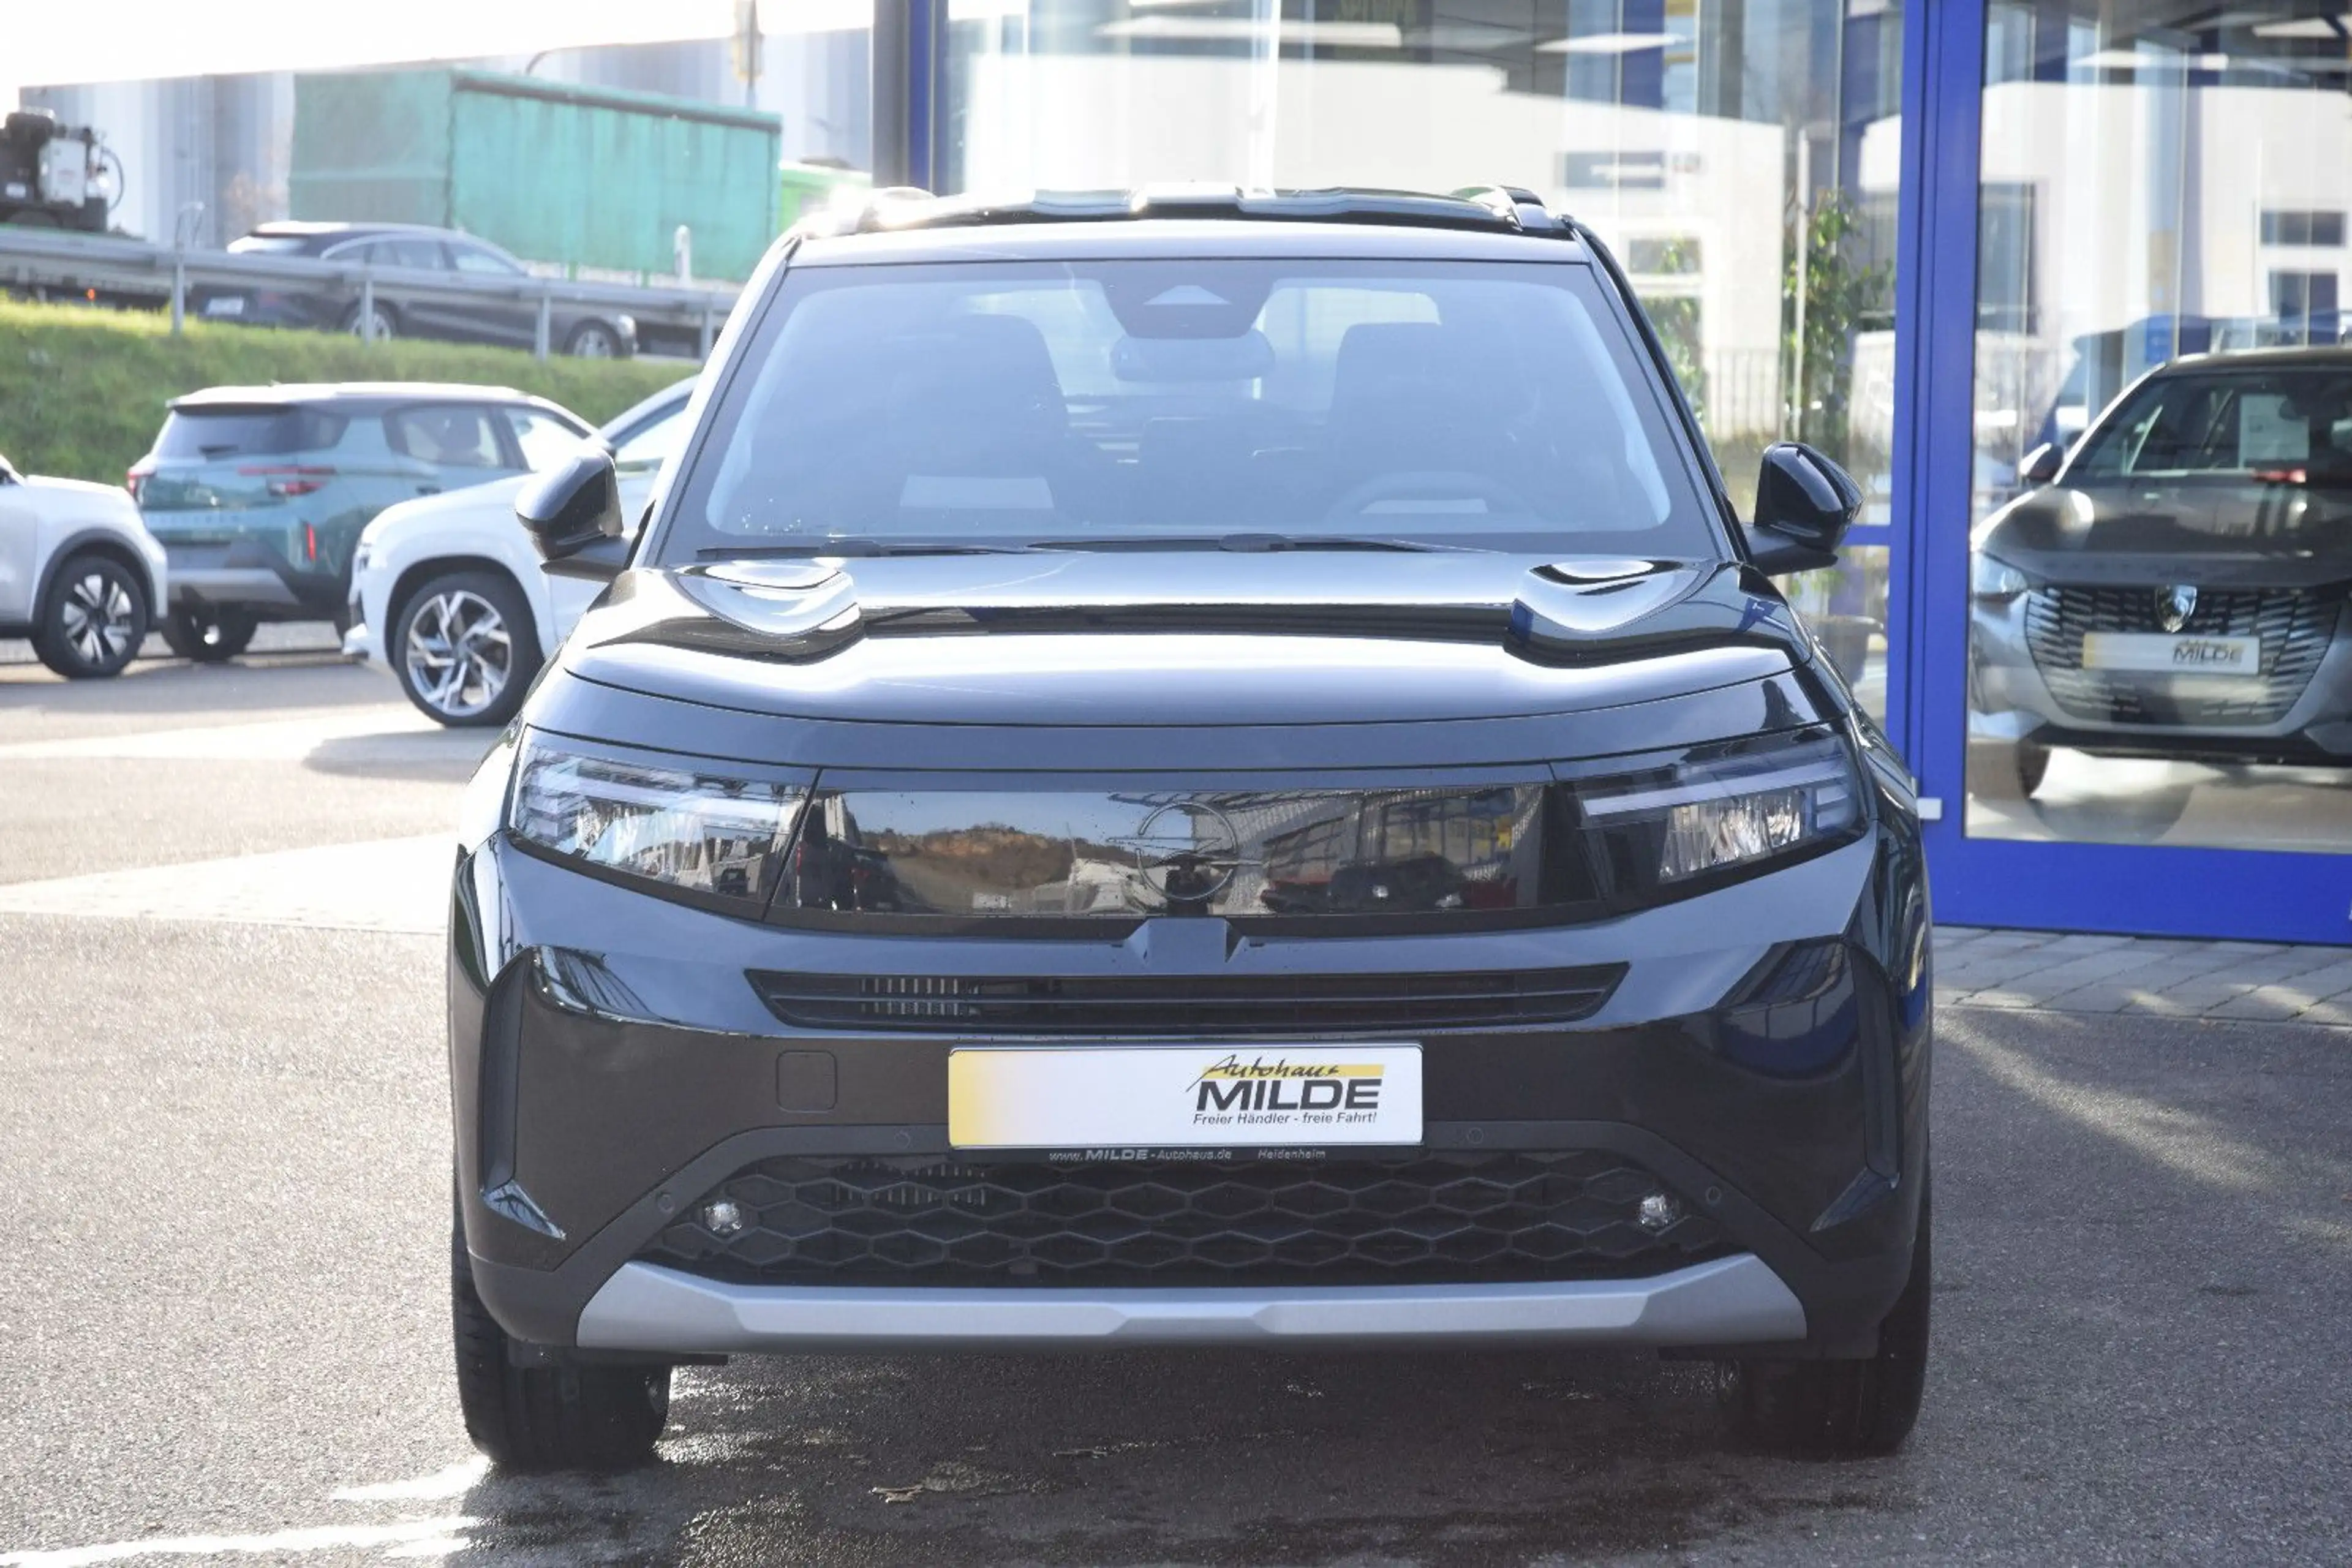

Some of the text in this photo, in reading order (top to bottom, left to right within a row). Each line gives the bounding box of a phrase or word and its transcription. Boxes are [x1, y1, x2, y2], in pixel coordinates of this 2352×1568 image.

[1186, 1054, 1340, 1092] Autohaus
[1196, 1079, 1382, 1111] MILDE
[1193, 1114, 1233, 1125] Freier
[1237, 1112, 1289, 1124] Händler
[1302, 1112, 1332, 1123] freie
[1337, 1112, 1377, 1123] Fahrt!
[1258, 1149, 1325, 1159] Heidenheim
